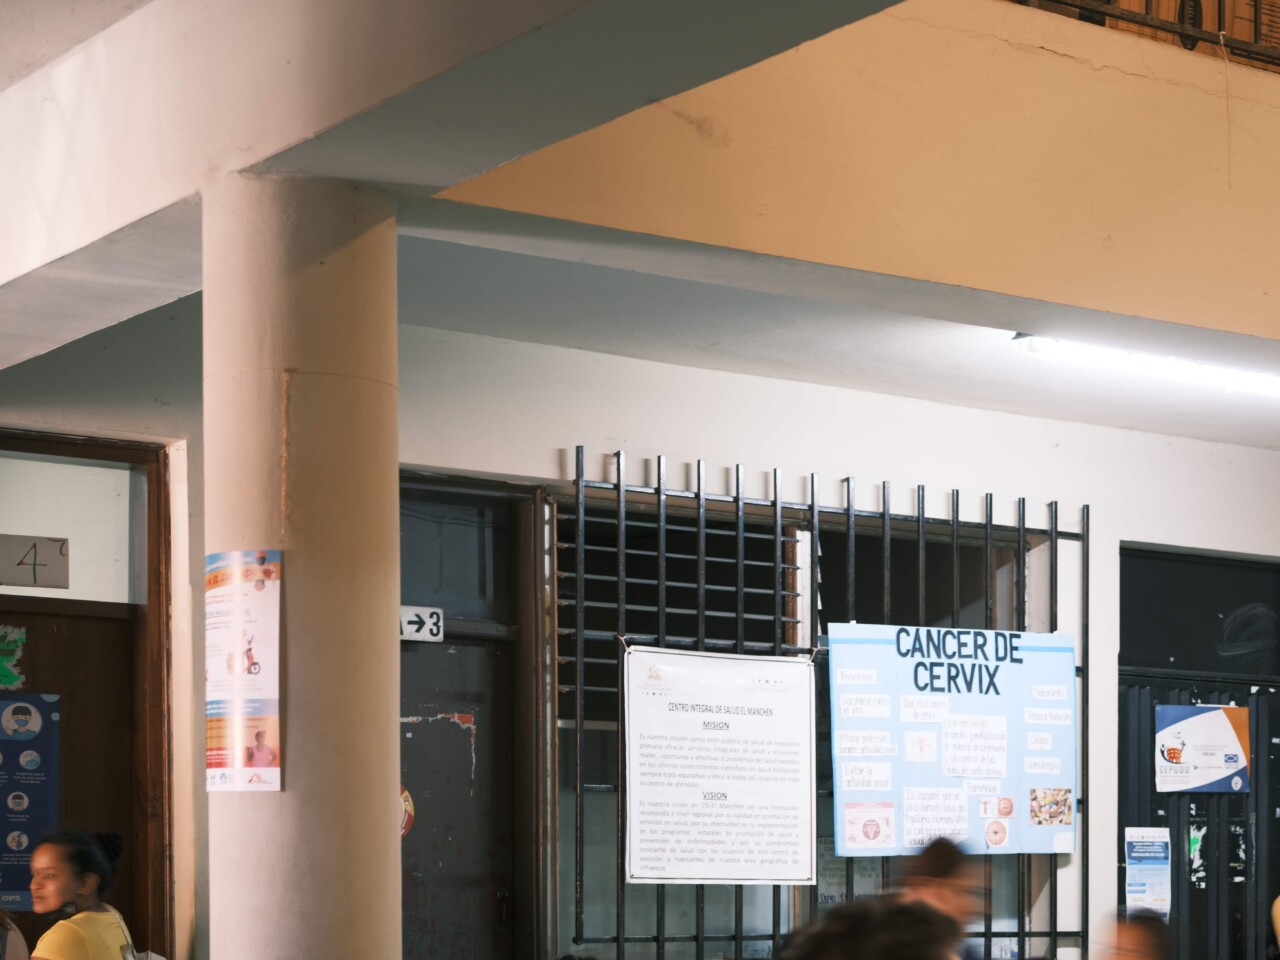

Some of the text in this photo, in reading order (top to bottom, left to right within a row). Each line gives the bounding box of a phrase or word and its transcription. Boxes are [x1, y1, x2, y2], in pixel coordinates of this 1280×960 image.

[16, 542, 47, 584] 4
[429, 611, 441, 637] 3
[896, 627, 1023, 664] CANCER DE
[913, 661, 1000, 695] CERVIX
[668, 702, 773, 717] CENTRO INTEGRAL DE SALUD EL MANCHEN
[703, 721, 730, 729] MISION
[1159, 765, 1190, 774] CEPUDO
